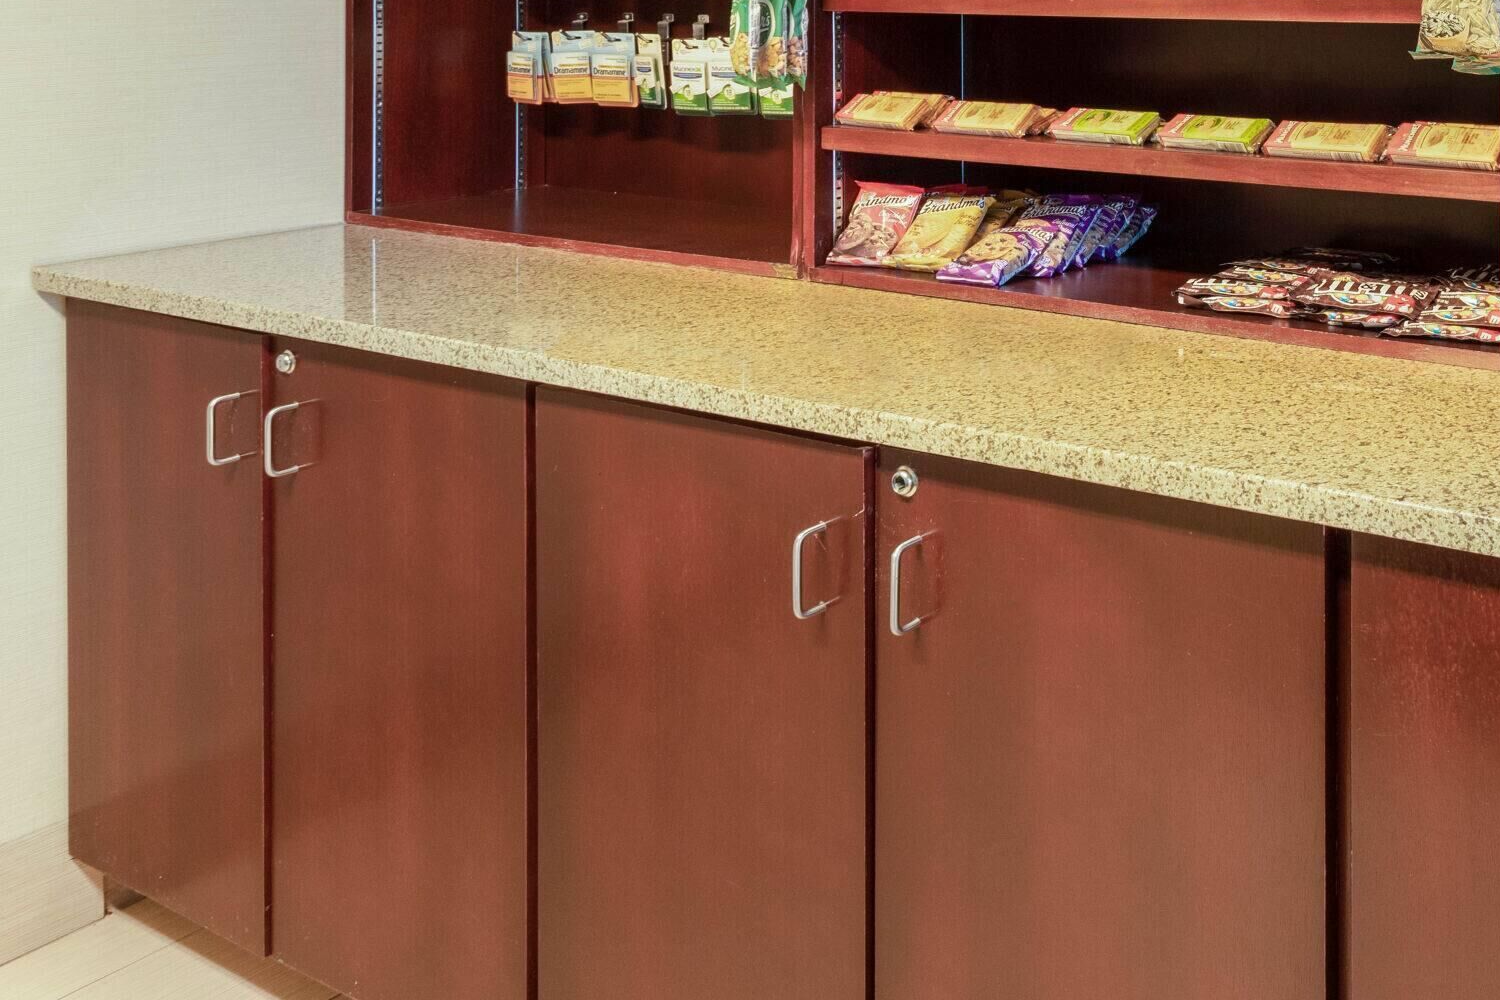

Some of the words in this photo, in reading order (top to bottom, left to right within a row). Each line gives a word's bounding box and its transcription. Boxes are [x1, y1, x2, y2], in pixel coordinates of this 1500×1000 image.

[554, 66, 588, 76] Dramamine
[593, 66, 626, 77] Dramamine
[919, 195, 986, 215] Grandma's
